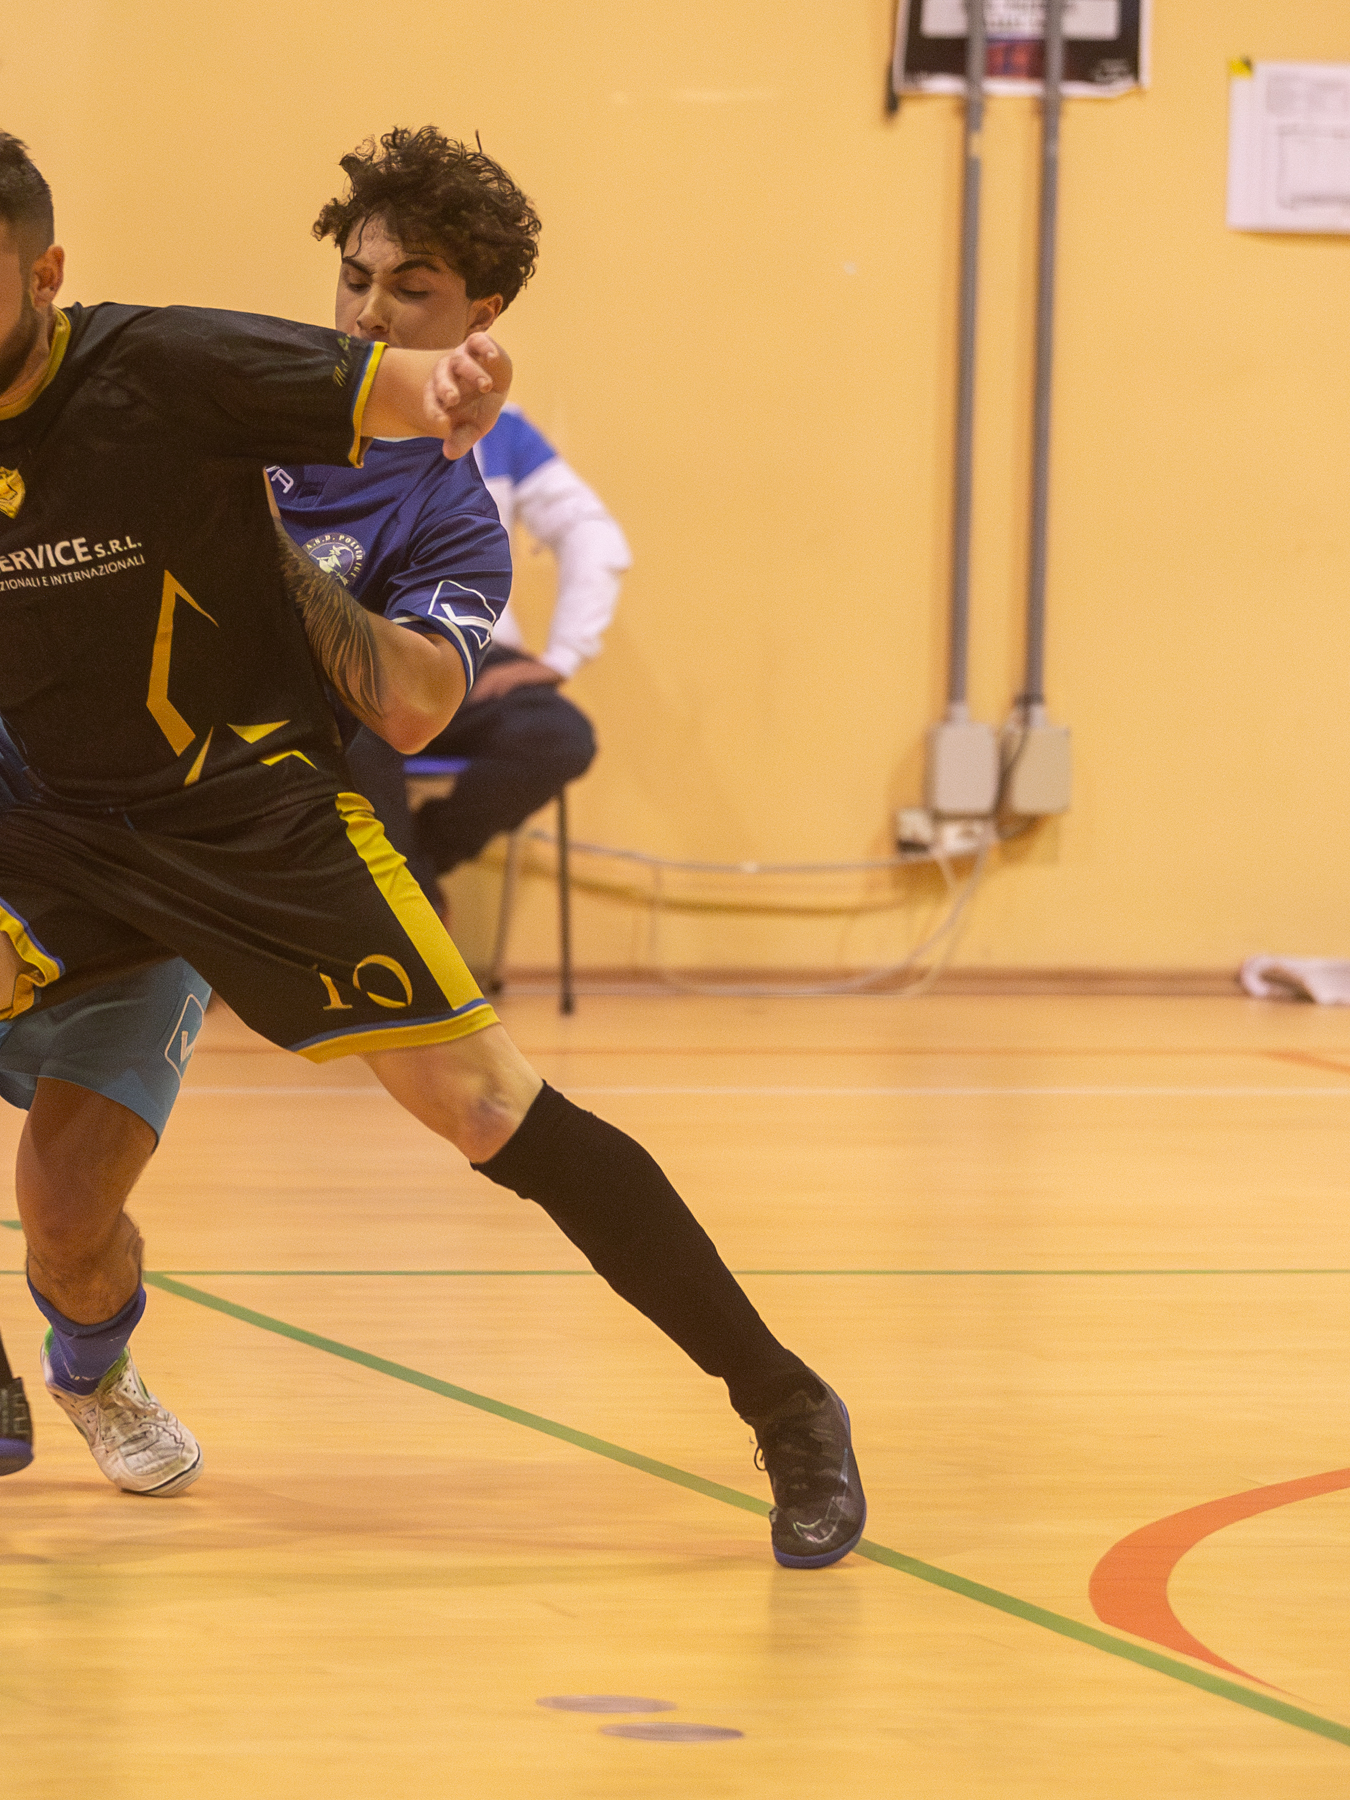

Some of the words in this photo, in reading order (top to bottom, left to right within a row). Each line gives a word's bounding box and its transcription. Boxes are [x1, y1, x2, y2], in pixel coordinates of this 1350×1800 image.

[93, 535, 143, 558] S.R.L.
[41, 576, 50, 587] E
[50, 553, 146, 586] INTERNAZIONALI
[312, 953, 413, 1011] 10
